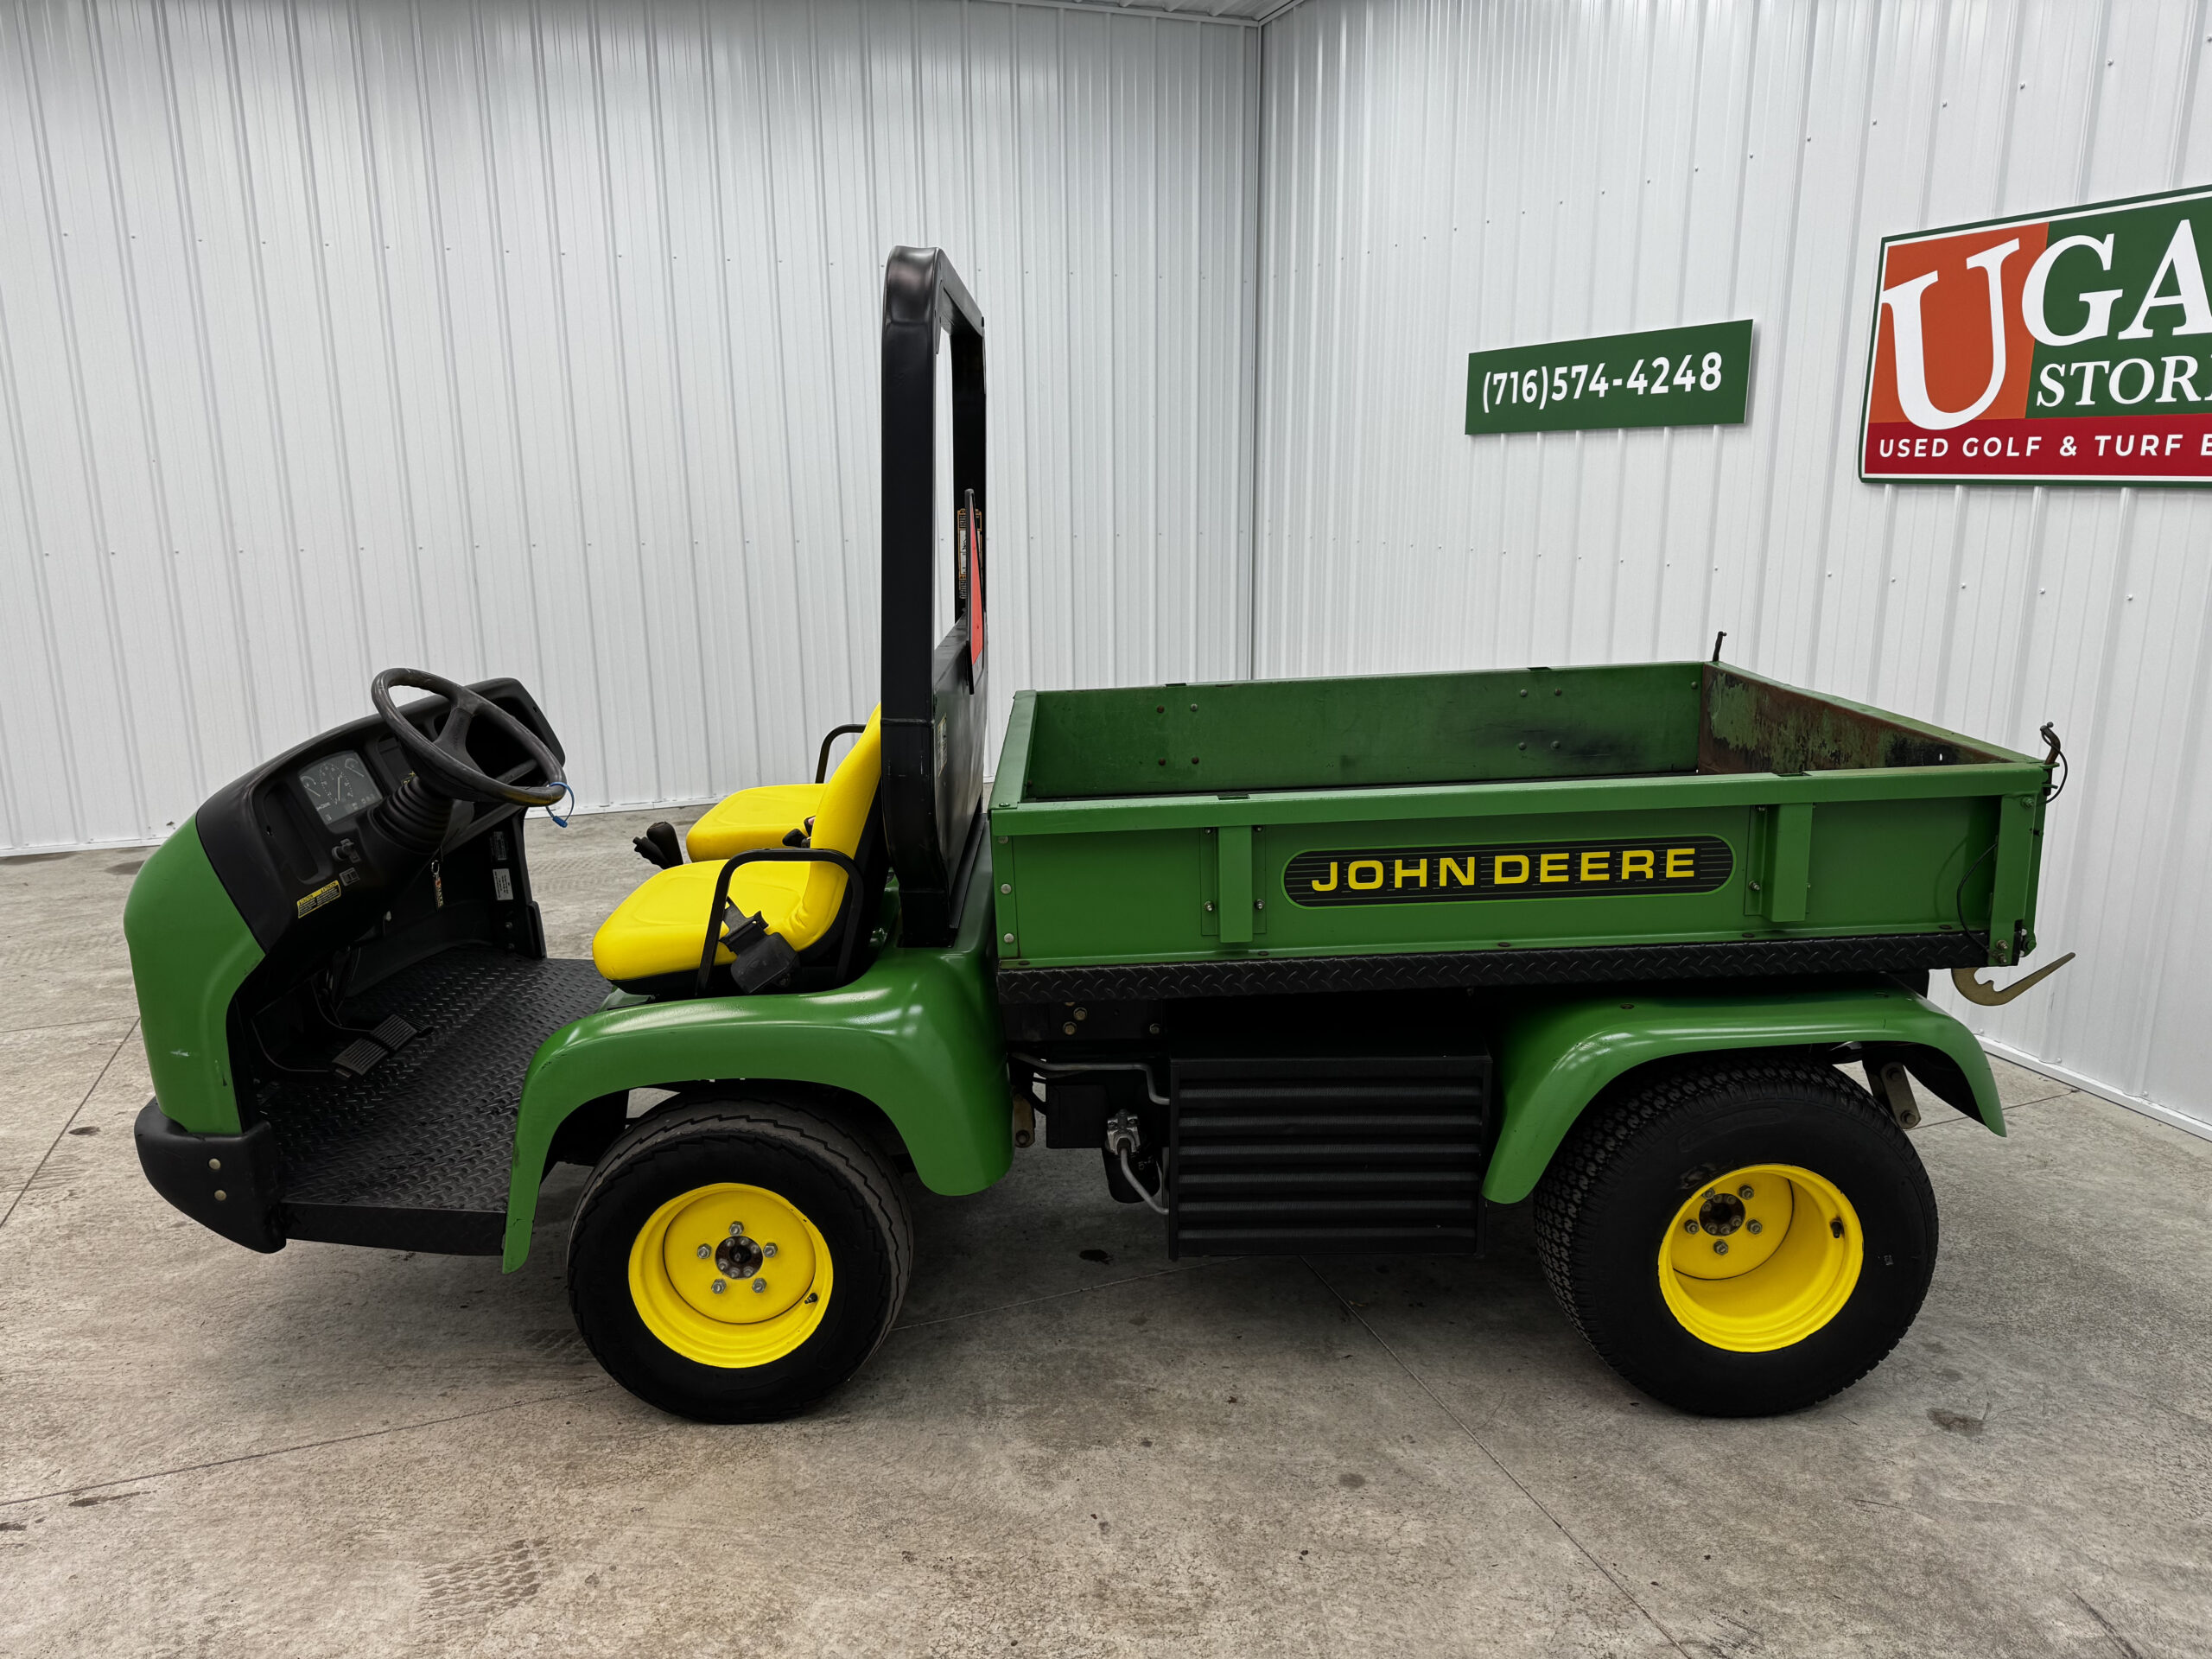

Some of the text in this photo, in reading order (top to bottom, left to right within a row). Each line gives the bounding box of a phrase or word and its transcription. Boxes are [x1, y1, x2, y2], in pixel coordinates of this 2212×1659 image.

[1482, 351, 1723, 414] (716)574-4248
[2035, 354, 2212, 408] STOR
[1878, 437, 1949, 458] USED
[1961, 436, 2043, 457] GOLF
[2058, 435, 2077, 457] &
[2094, 434, 2183, 457] TURF
[1311, 848, 1696, 892] JOHN DEERE
